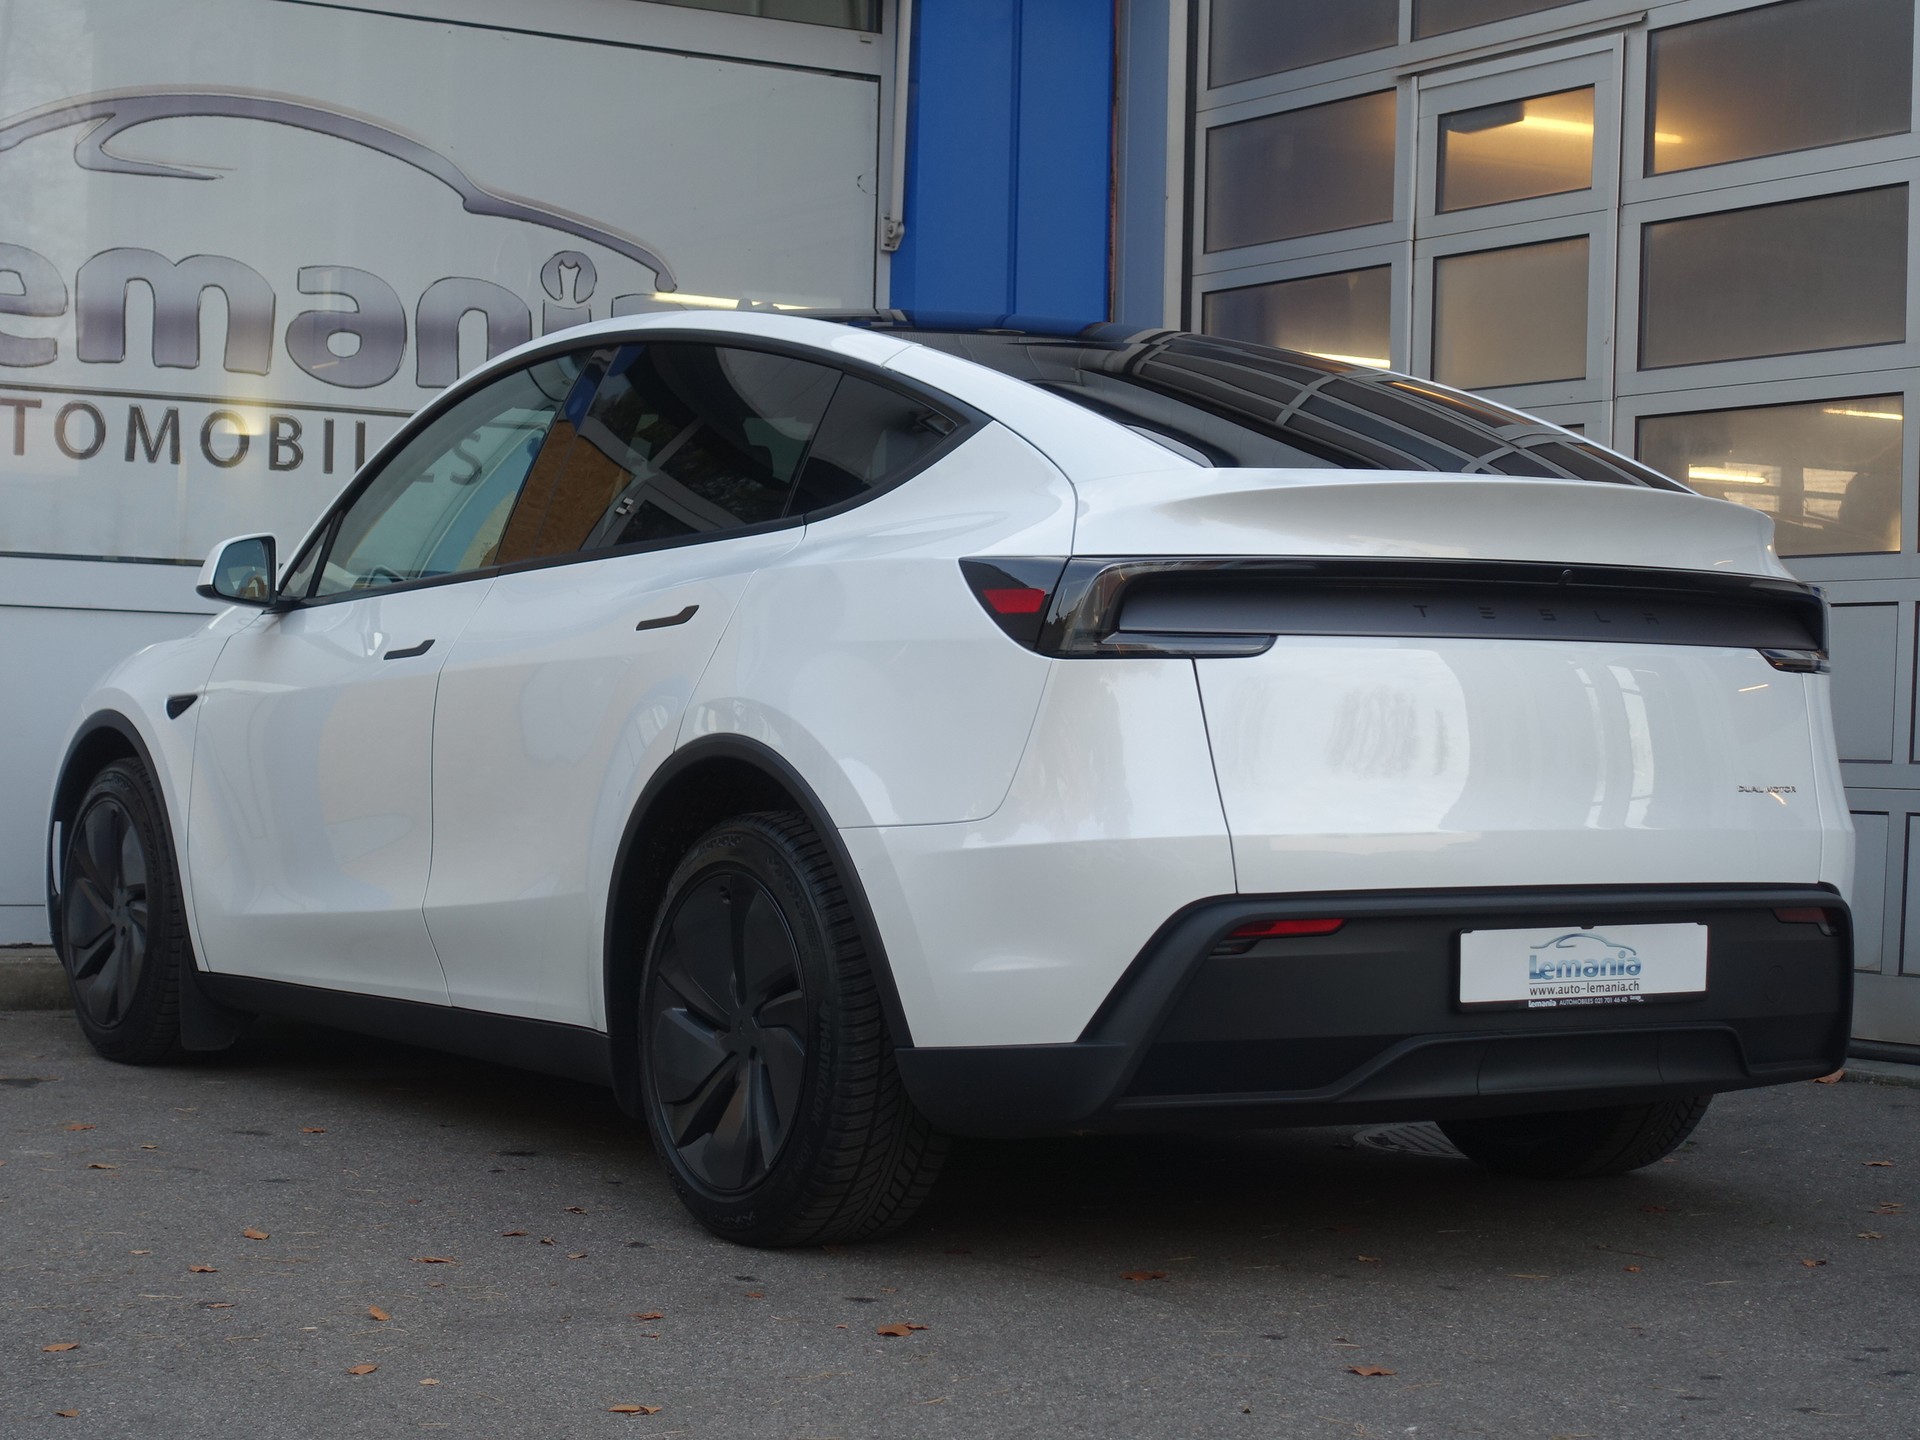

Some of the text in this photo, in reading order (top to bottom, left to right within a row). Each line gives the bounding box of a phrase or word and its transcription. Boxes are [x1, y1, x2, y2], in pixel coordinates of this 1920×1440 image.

[0, 243, 688, 387] emani
[1413, 605, 1659, 625] TESLA
[1529, 951, 1641, 979] Lemania
[1529, 982, 1639, 996] www.auto-lemania.ch
[1559, 998, 1594, 1006] AUTOMOBILES
